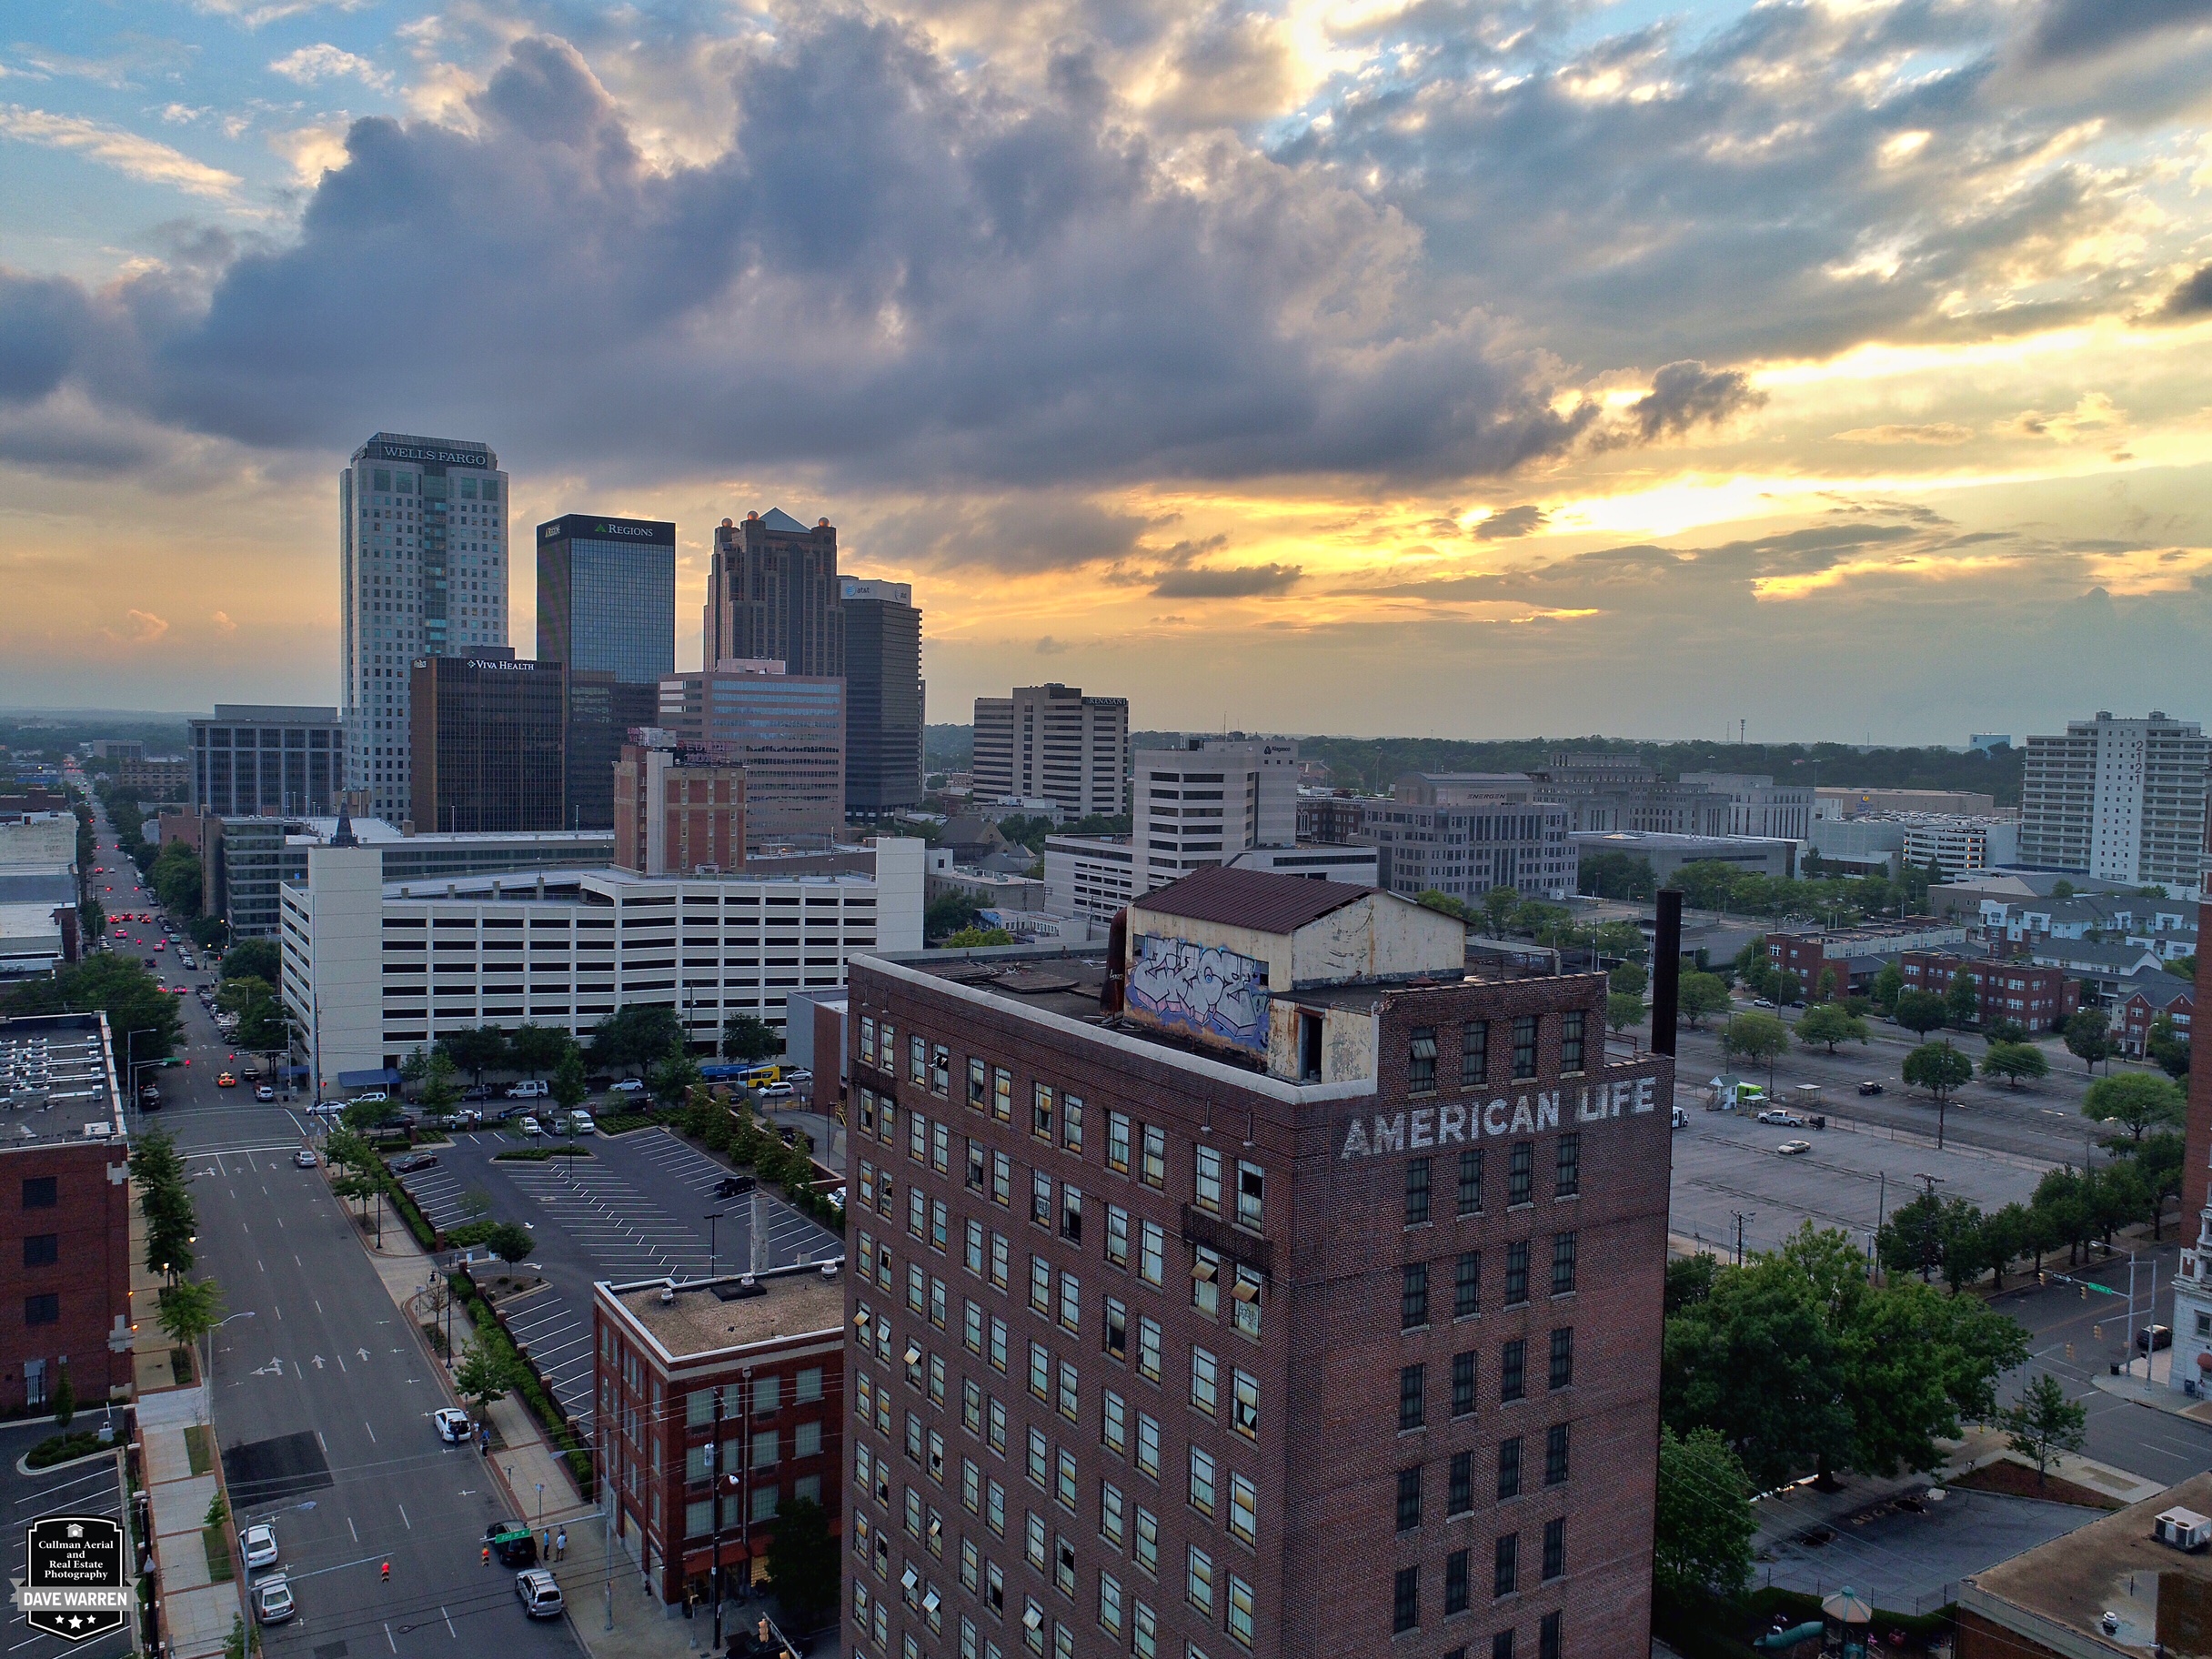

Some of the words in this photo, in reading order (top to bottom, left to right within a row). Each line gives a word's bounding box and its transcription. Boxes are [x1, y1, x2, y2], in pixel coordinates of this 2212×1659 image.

[384, 447, 435, 460] WELLS
[437, 452, 486, 465] FARGO
[608, 524, 653, 537] REGIONS
[2135, 740, 2143, 785] 2121
[1342, 1091, 1560, 1160] AMERICAN
[1575, 1077, 1656, 1122] LIFE
